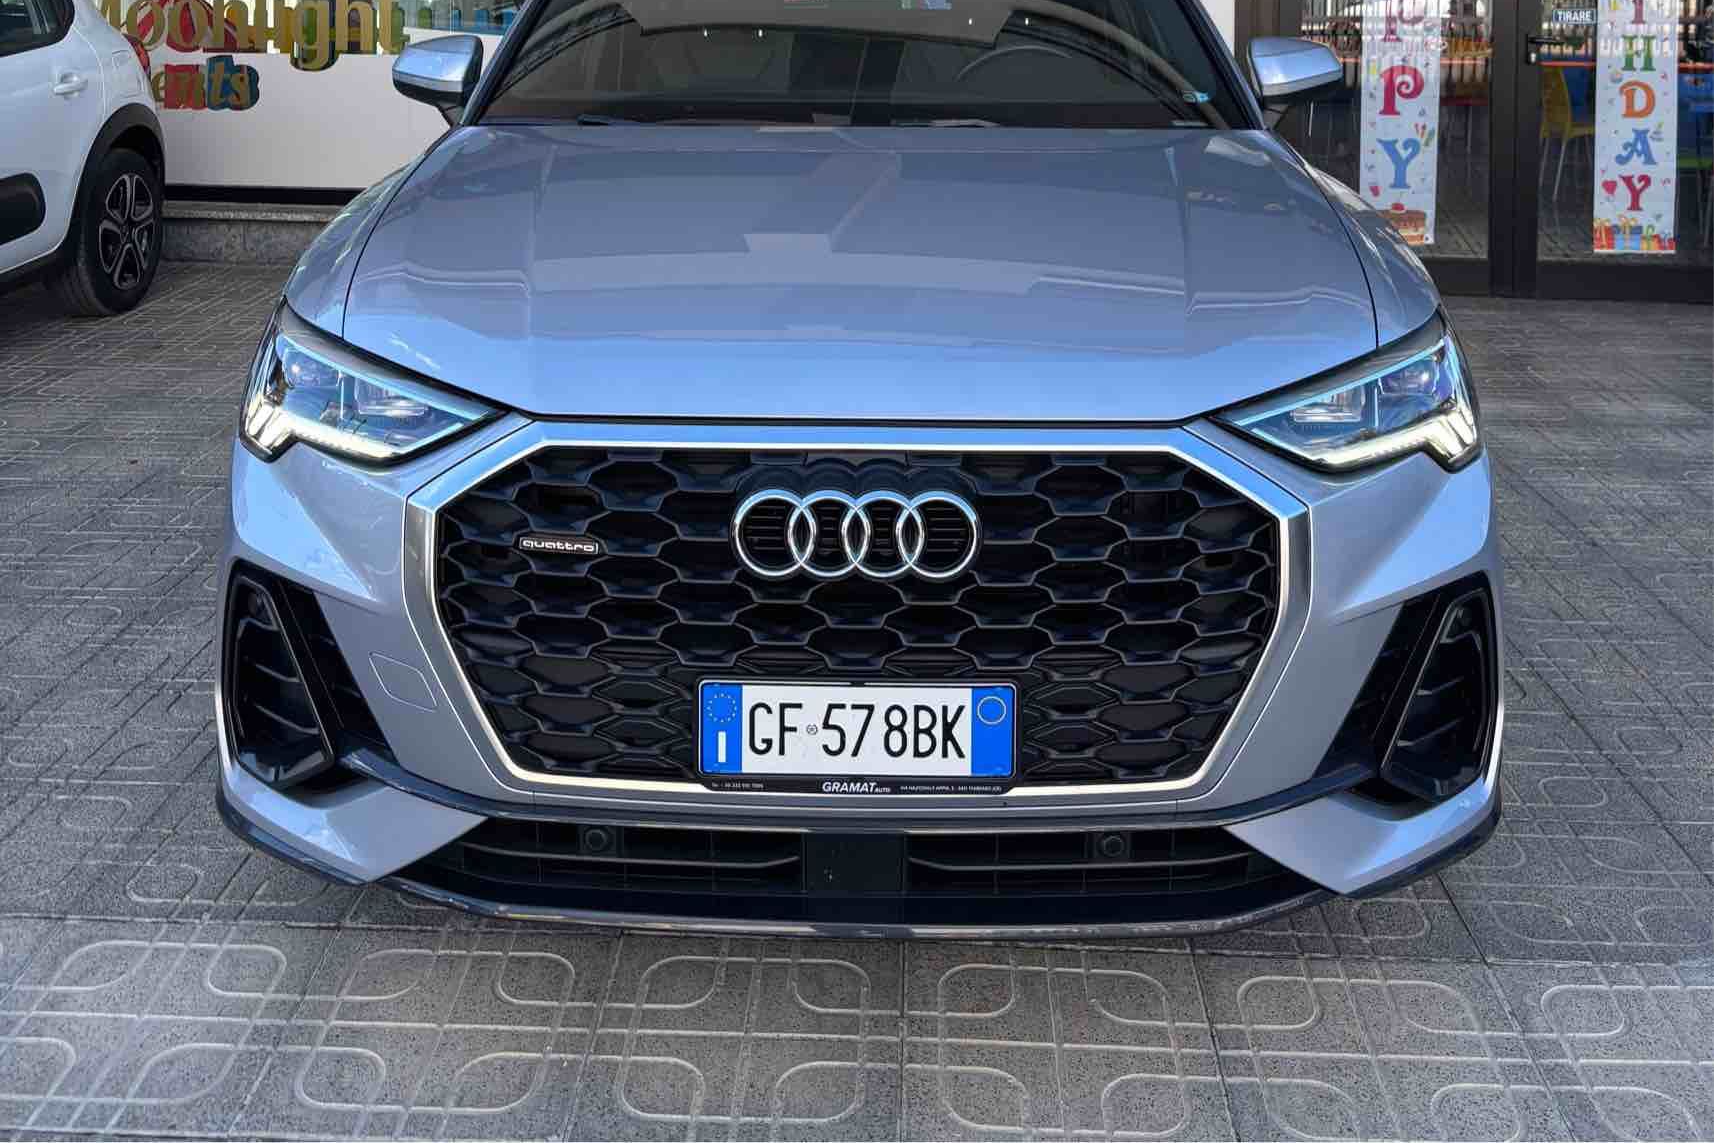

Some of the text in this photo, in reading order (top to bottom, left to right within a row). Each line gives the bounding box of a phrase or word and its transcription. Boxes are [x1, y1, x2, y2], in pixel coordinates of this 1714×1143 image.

[1556, 10, 1592, 22] TIRARE
[151, 63, 252, 110] ents
[522, 539, 595, 552] quattro
[748, 702, 966, 759] GF 578BK
[717, 731, 727, 763] I
[821, 781, 876, 794] GRAMAT
